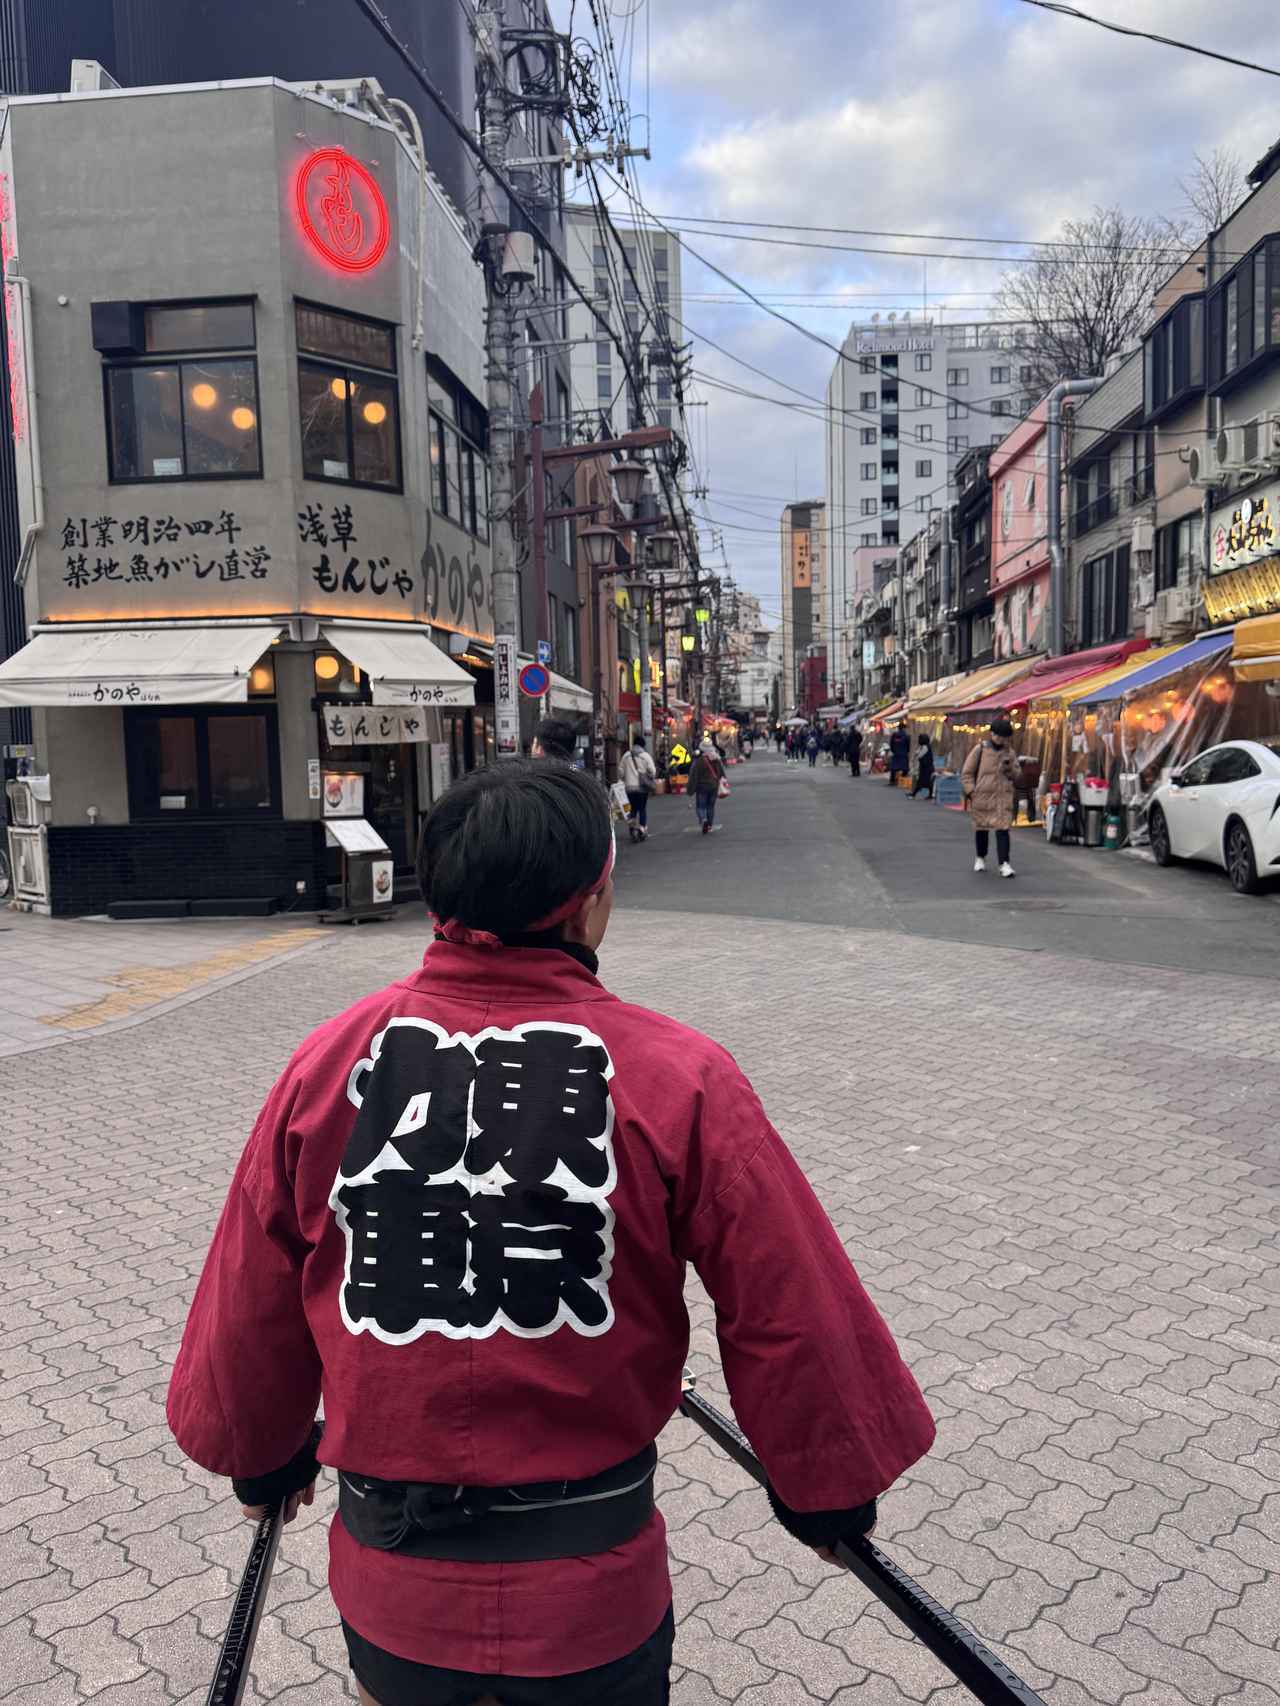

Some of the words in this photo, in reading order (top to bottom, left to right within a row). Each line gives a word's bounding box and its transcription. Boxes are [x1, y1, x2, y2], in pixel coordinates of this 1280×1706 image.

[61, 510, 241, 550] 創業明治四年
[298, 503, 357, 552] 浅草
[63, 546, 271, 589] 築地魚がし直営
[312, 554, 414, 599] もんじゃ
[421, 508, 484, 633] かのや
[93, 682, 141, 702] かのや
[410, 685, 444, 703] かのや
[329, 714, 421, 738] もんじゃ
